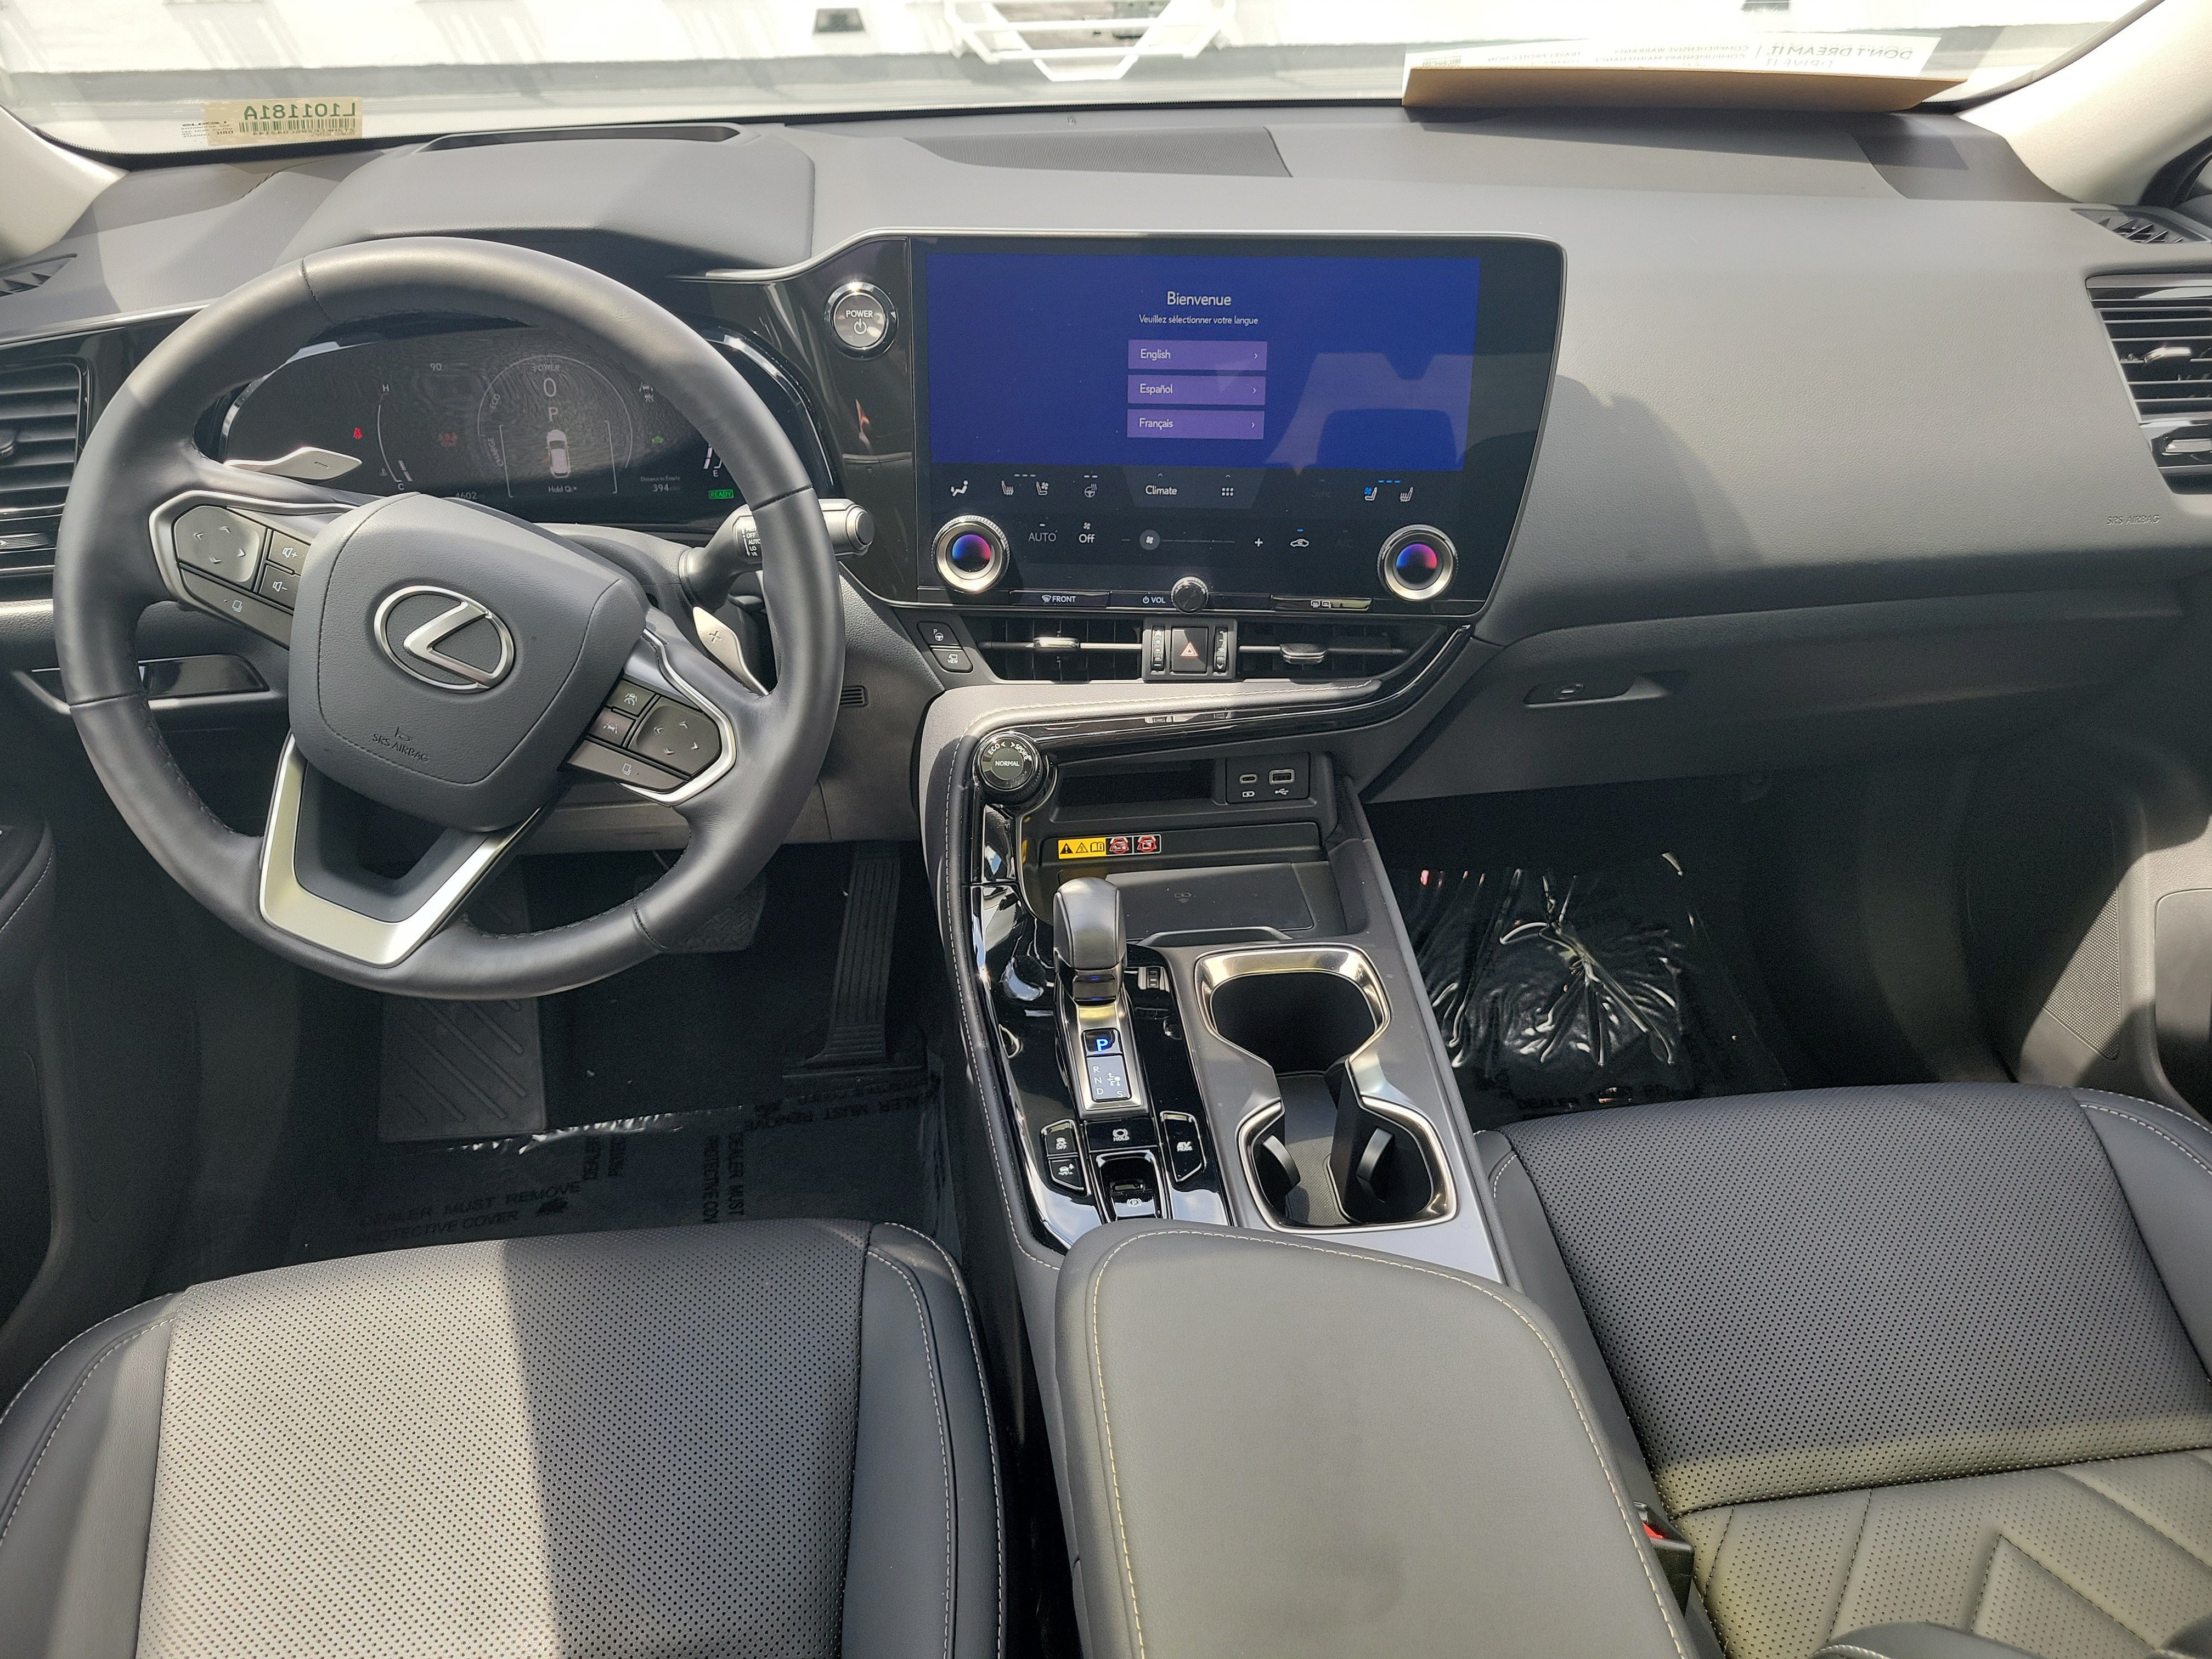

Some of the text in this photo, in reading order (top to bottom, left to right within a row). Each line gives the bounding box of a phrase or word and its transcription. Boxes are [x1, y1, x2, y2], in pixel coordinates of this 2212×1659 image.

[1166, 291, 1232, 306] Bienvenue
[845, 310, 873, 318] POWER
[1138, 314, 1167, 324] Veuillez
[1169, 314, 1212, 324] sélectionner
[1234, 315, 1259, 326] langue
[1140, 348, 1171, 361] English
[382, 384, 390, 393] H
[543, 377, 557, 397] 0
[1139, 383, 1173, 396] Español
[489, 393, 501, 410] ECO
[549, 407, 558, 422] P
[1138, 417, 1173, 431] Français
[653, 484, 669, 492] 394
[710, 490, 733, 499] READY
[1145, 485, 1177, 496] Climate
[2106, 515, 2160, 526] SRS AIRBAG
[1028, 532, 1056, 543] AUTO
[1078, 533, 1095, 544] Off
[1052, 595, 1076, 603] FRONT
[372, 733, 430, 763] SRS AIRBAG
[988, 743, 1001, 755] ECO
[1014, 743, 1031, 762] SPORT
[1096, 1039, 1108, 1052] P
[444, 1196, 496, 1215] MUST
[505, 1181, 582, 1205] REMOVE
[462, 1210, 520, 1230] COVER
